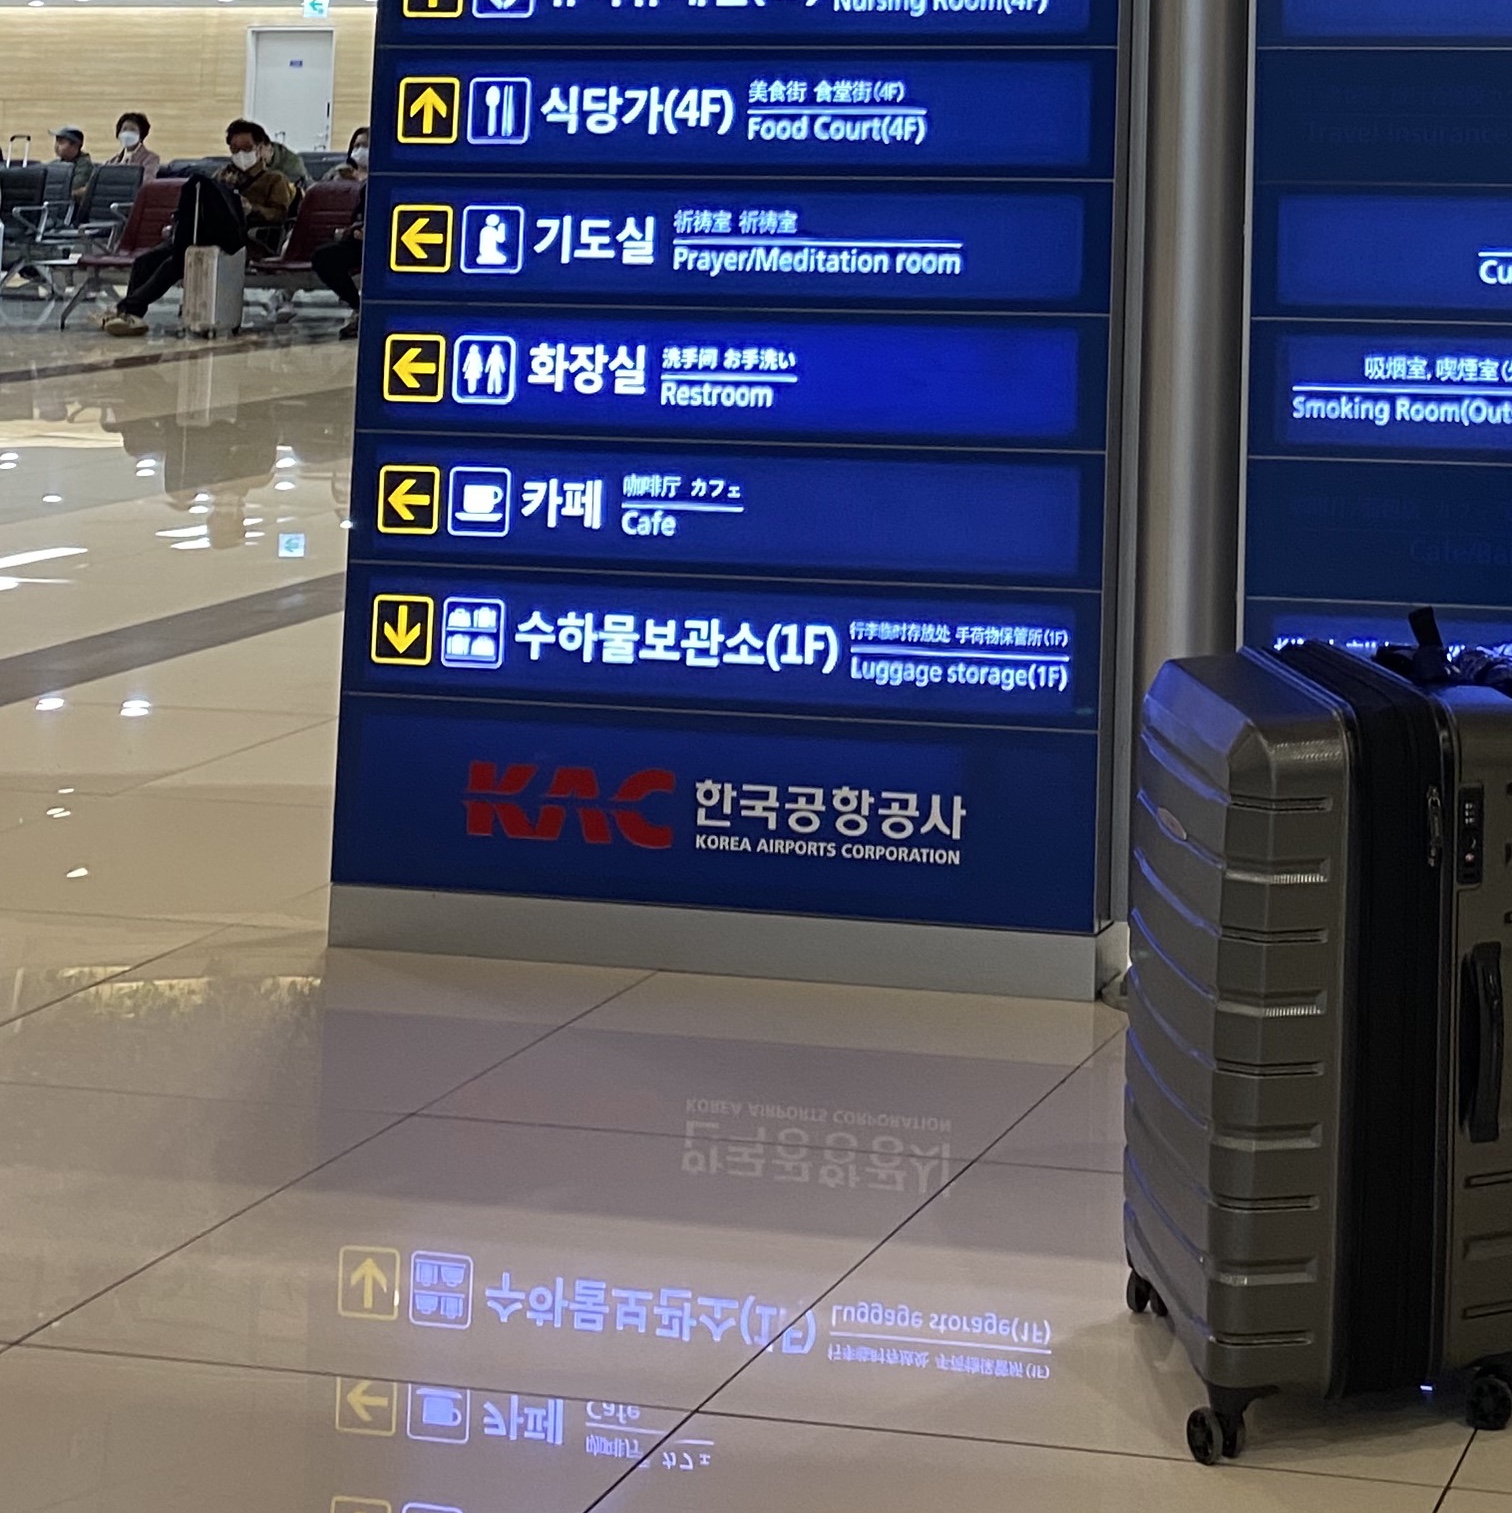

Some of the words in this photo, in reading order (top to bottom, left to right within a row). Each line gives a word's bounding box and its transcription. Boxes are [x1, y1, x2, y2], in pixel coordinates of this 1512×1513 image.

[541, 86, 734, 135] 식당가(4F)
[748, 116, 808, 141] Food
[814, 115, 927, 145] Court(4F)
[533, 215, 655, 266] 기도실
[673, 247, 889, 277] Prayer/Meditation
[895, 251, 962, 275] room
[527, 343, 647, 395] 화장실
[661, 382, 774, 408] Restroom
[1293, 399, 1390, 425] Smoking
[521, 478, 603, 530] 카페
[690, 478, 741, 499] カフェ
[621, 510, 676, 537] Cafe
[514, 610, 839, 674] 수하물보관소(1F)
[850, 654, 942, 687] Luggage
[947, 663, 1068, 692] storage(1F)
[462, 760, 677, 850] KAC
[696, 778, 967, 841] 한국공항공사
[696, 833, 752, 854] KOREA
[756, 837, 837, 858] AIRPORTS
[841, 843, 960, 866] CORPORATION
